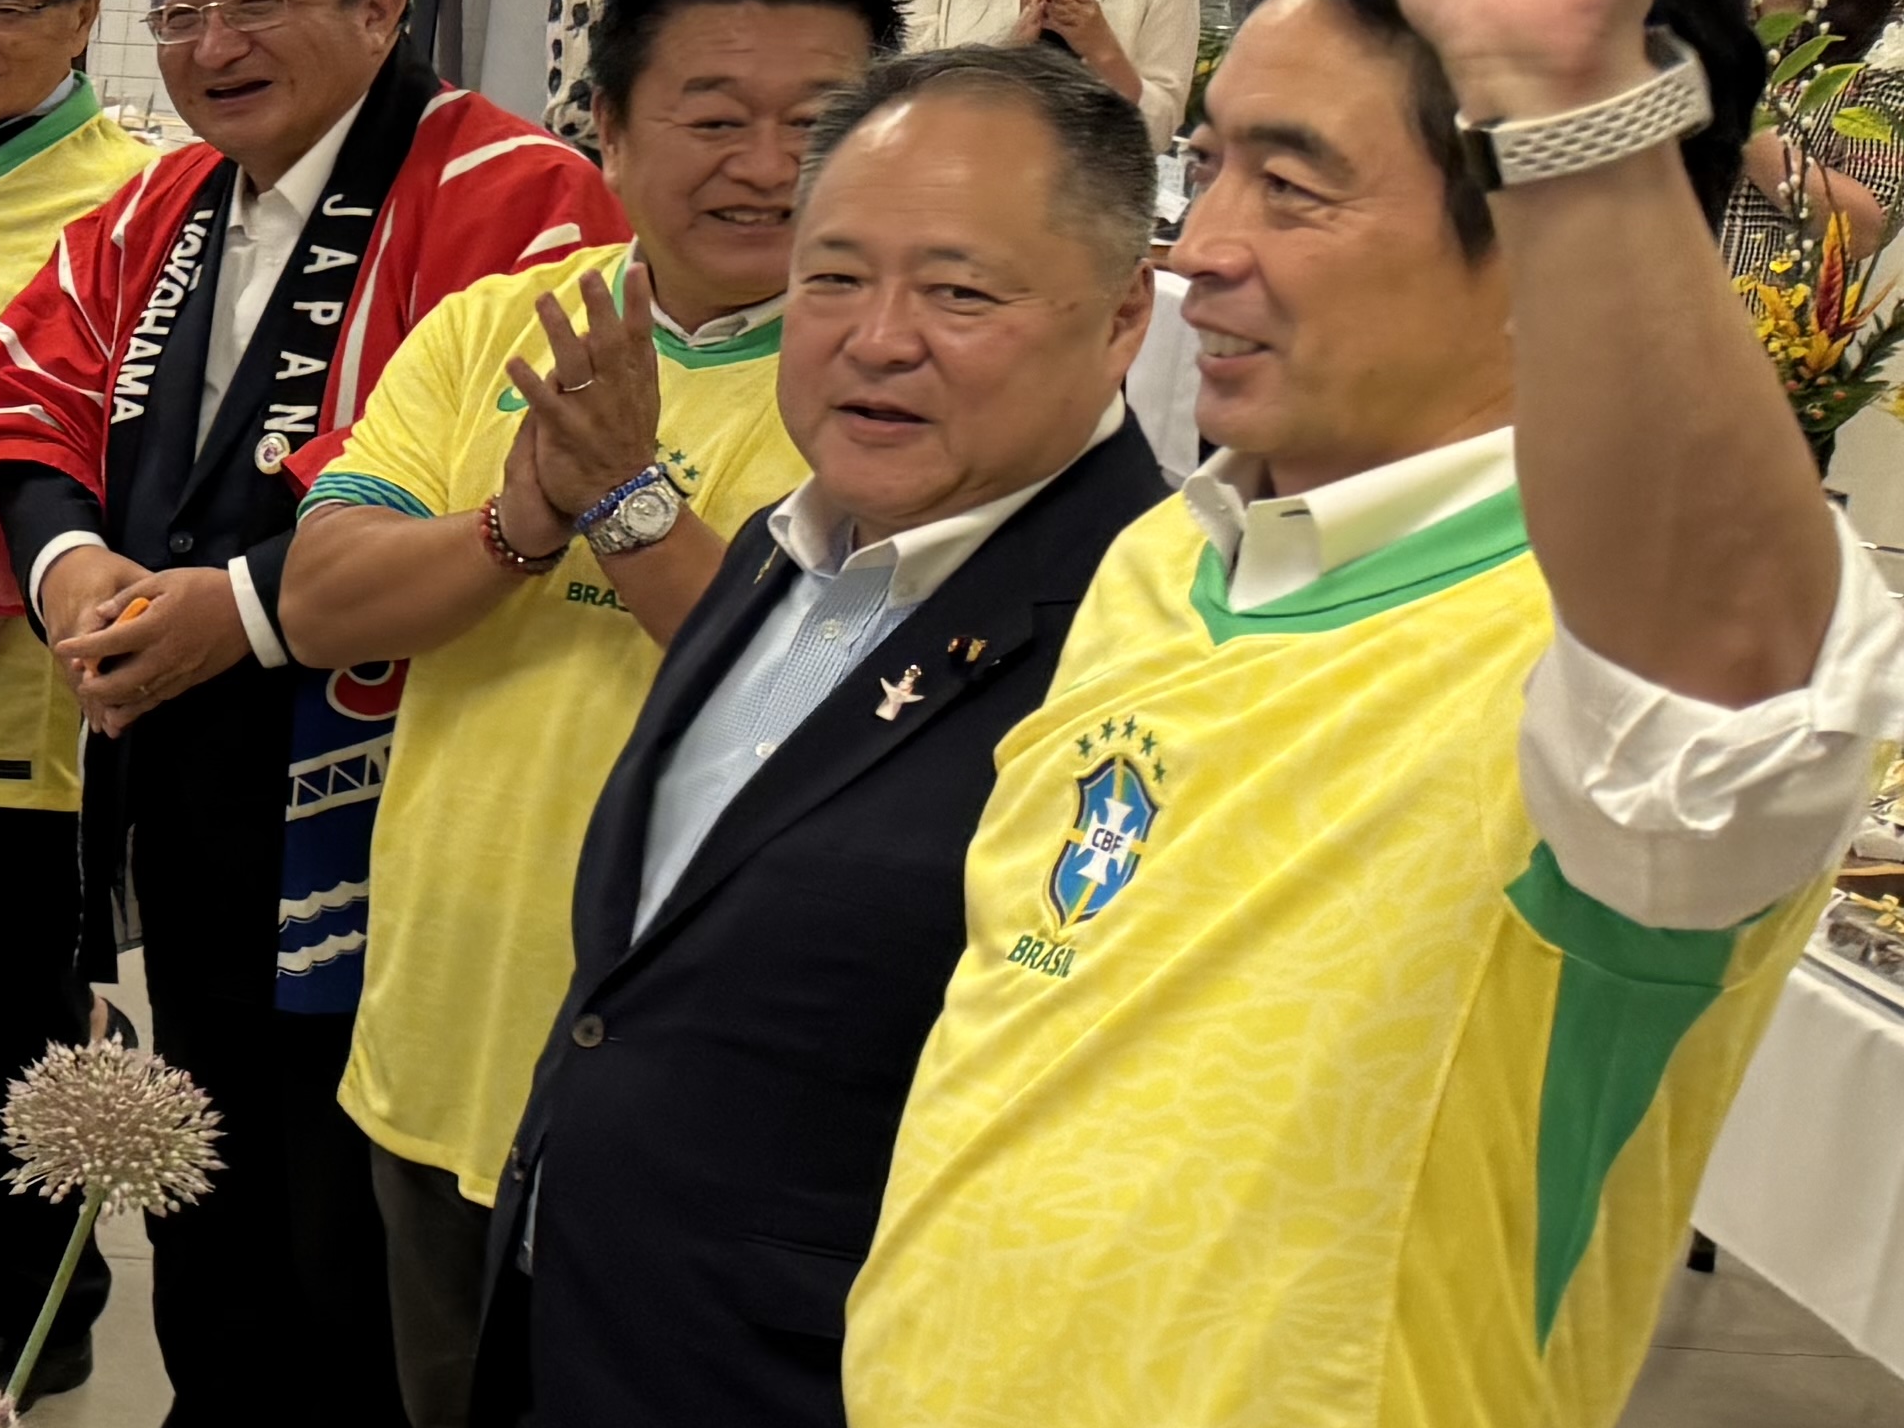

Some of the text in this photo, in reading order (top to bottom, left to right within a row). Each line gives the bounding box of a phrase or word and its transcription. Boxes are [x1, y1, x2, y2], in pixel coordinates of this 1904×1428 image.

[263, 193, 374, 433] JAPAN
[566, 581, 630, 613] BRA
[1091, 827, 1125, 855] CBF
[1006, 934, 1077, 978] BRASIL
